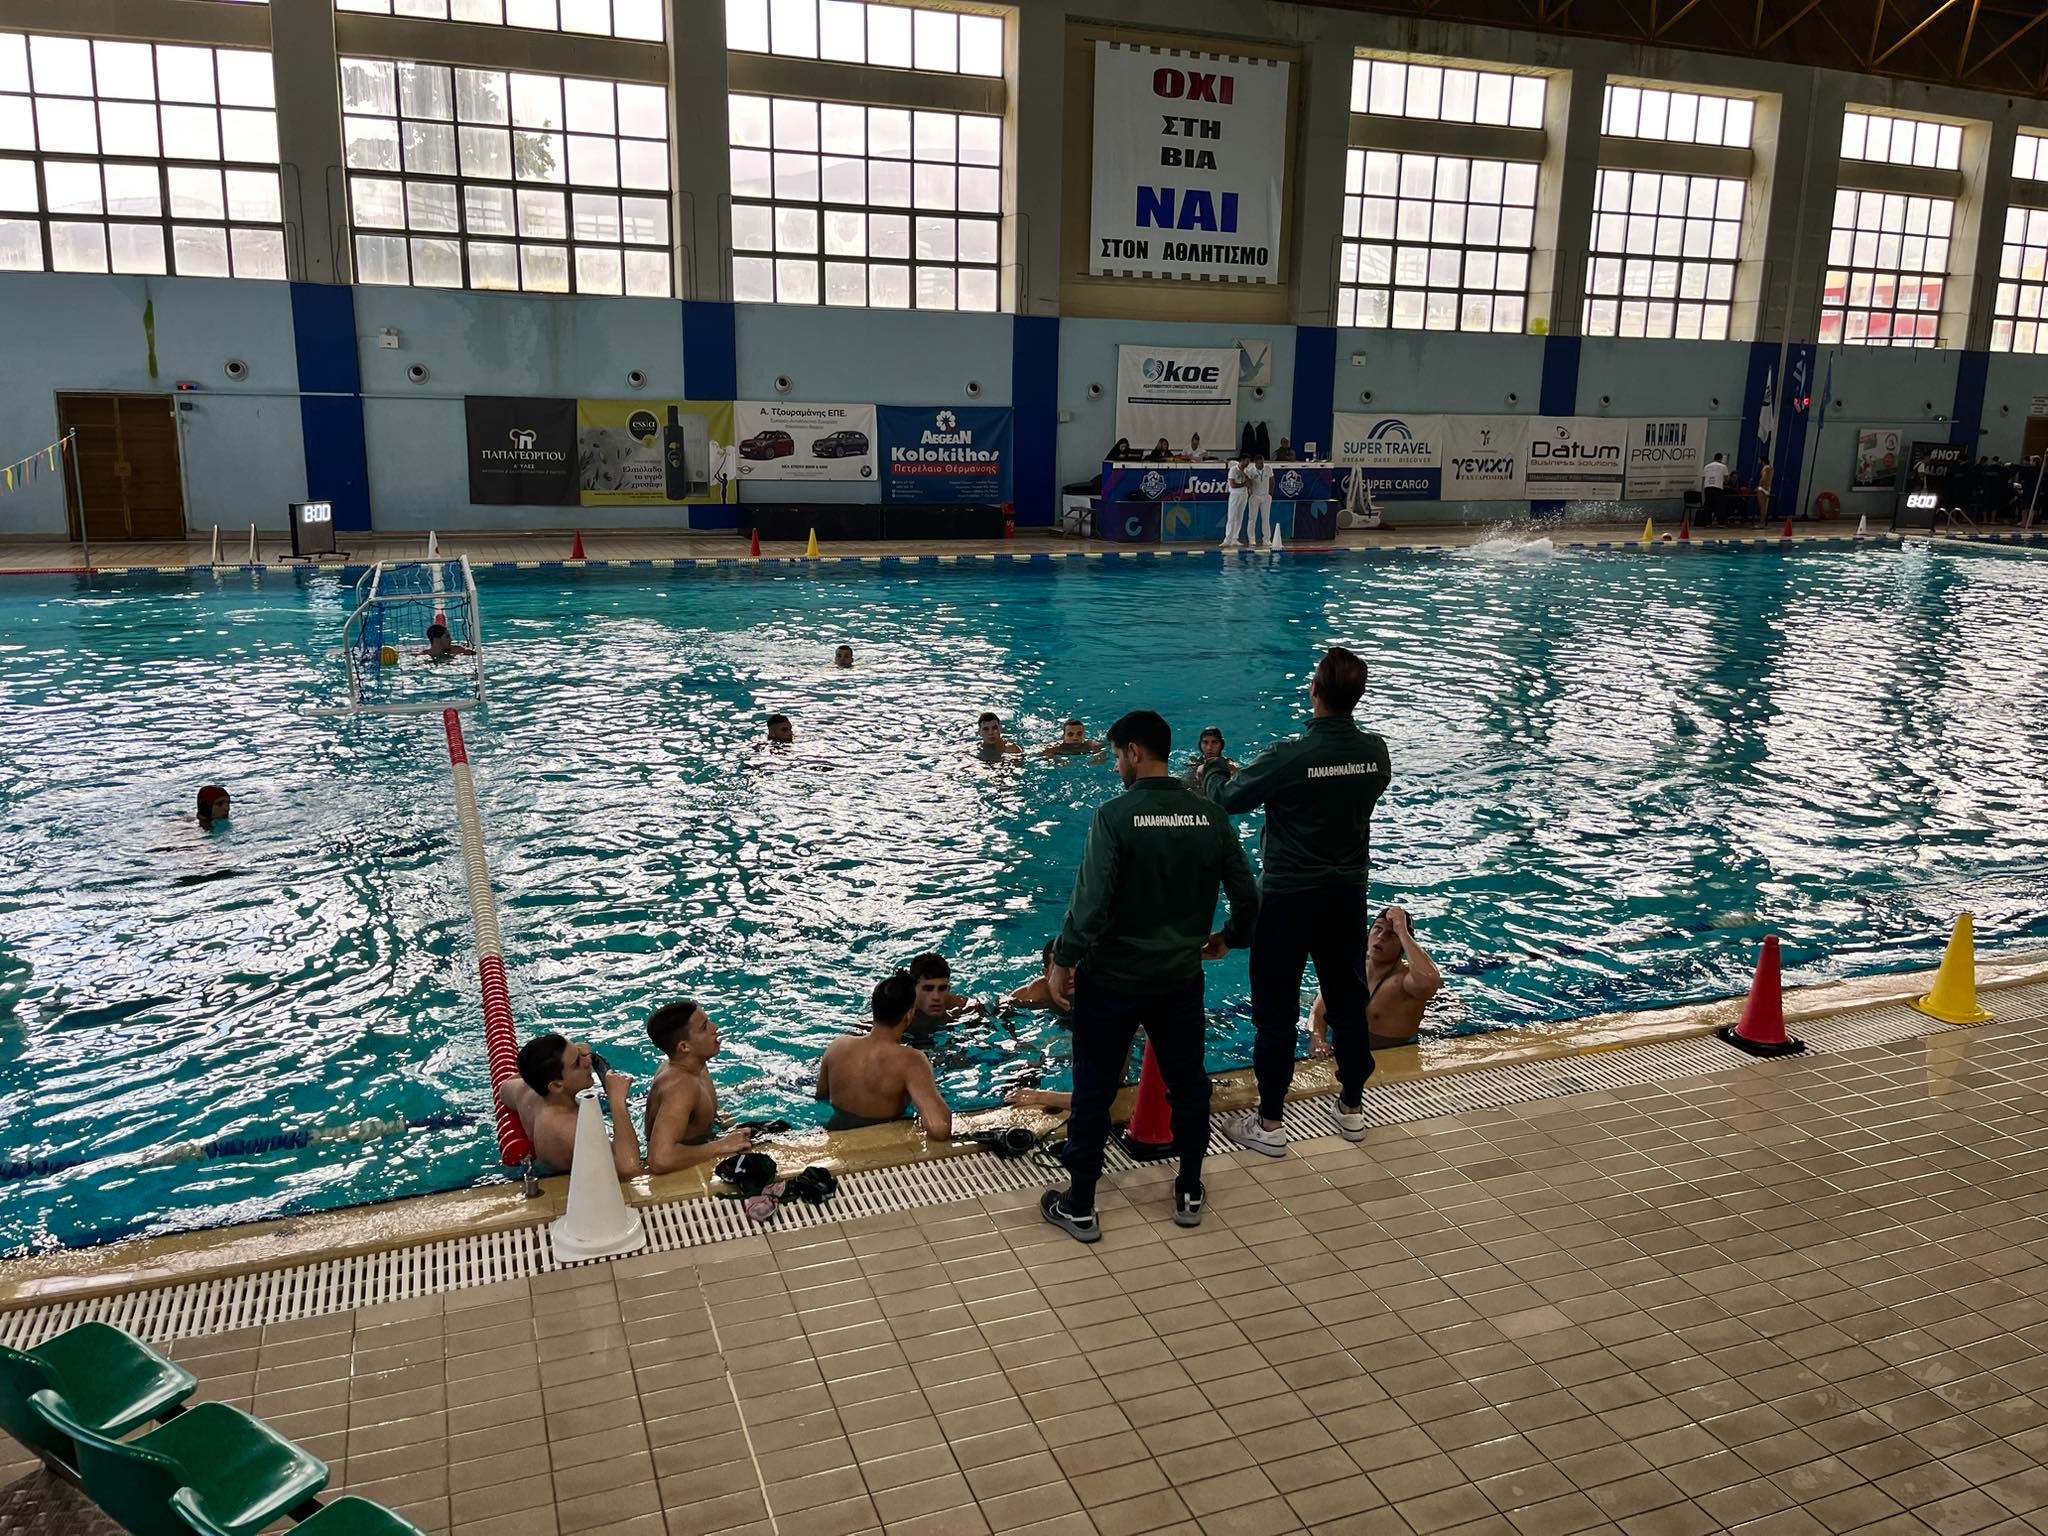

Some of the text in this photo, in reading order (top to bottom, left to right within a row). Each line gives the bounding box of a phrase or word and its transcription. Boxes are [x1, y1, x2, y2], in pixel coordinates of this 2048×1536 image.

[1153, 67, 1235, 105] ΟΧΙ
[1161, 115, 1222, 140] ΣΤΗ
[1160, 147, 1218, 170] ΒΙΑ
[1136, 186, 1239, 233] ΝΑΙ
[1101, 238, 1269, 266] ΣΤΟΝ ΑΘΛΗΤΙΣΜΟ
[772, 408, 826, 418] Τζουραμάνης
[481, 450, 566, 461] ΠΑΠΑΓΕΩΡΓΙΟΥ
[891, 446, 1000, 463] Kolokithas
[1343, 442, 1432, 454] SUPER TRAVEL
[1531, 441, 1620, 459] Datum
[894, 463, 997, 475] Πετρέλαιο Θέρμανσης
[1361, 479, 1429, 489] SUPER CARGO
[1906, 494, 1938, 509] 8:00
[304, 503, 331, 523] 8:00
[1307, 762, 1366, 778] ΠΑΝΑΘΗΝΑΪΚΟΣ
[1133, 813, 1195, 828] ΠΑΝΑΘΗΝΑΪΚΟΣ
